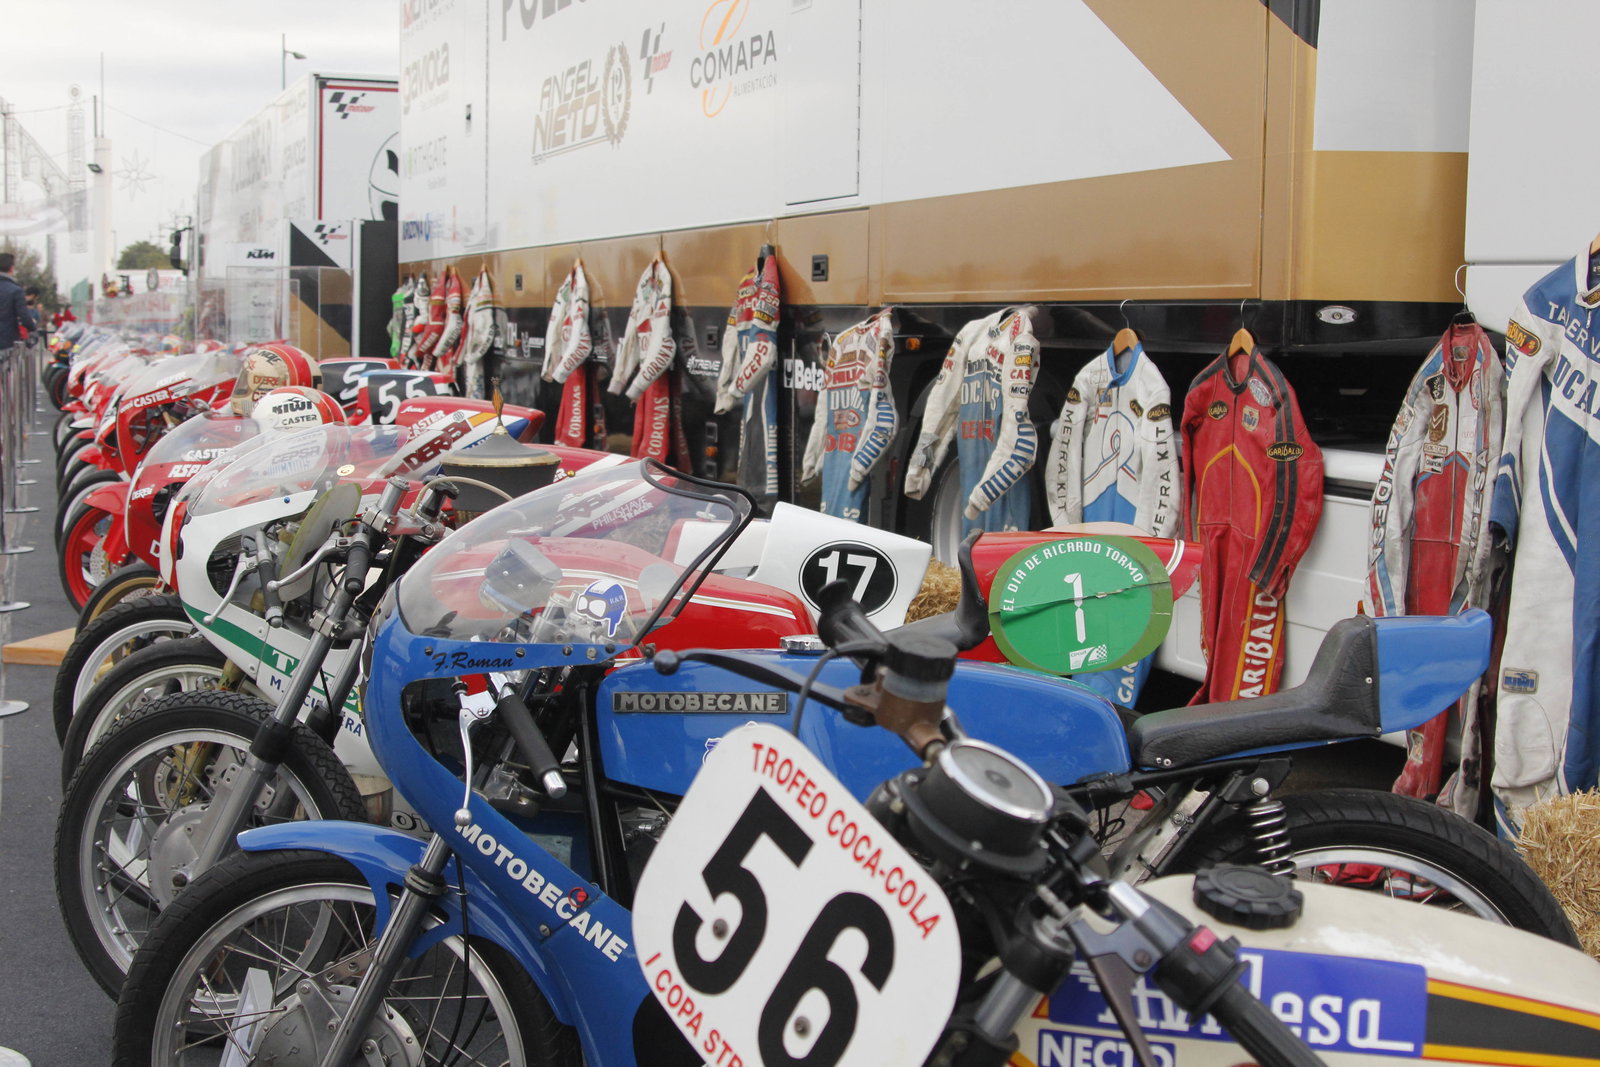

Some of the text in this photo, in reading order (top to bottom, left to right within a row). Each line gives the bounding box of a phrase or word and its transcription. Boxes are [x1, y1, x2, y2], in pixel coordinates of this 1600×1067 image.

[690, 30, 777, 88] COMAPA
[532, 90, 601, 155] NIETO
[246, 249, 276, 260] KTM
[641, 336, 675, 382] CORONAS
[794, 359, 824, 392] Beta
[133, 389, 170, 408] CASTER
[281, 414, 318, 427] CASTER
[567, 385, 582, 438] CORONAS
[648, 396, 671, 456] CORONAS
[271, 446, 321, 466] CEPSA
[854, 391, 895, 469] DUCADOS
[980, 410, 1037, 502] DUCADOS
[591, 496, 648, 530] PHILISHAVE
[1372, 431, 1398, 567] AVIDESA
[818, 550, 878, 603] 17
[1003, 540, 1145, 612] EL DIA DE RICARDO TORMO
[620, 693, 781, 712] MOTOBECANE
[752, 743, 942, 940] TROFEO COCA-COLA
[454, 822, 629, 963] MOTOBECANE
[673, 785, 896, 1067] 56
[654, 968, 706, 1037] COPA
